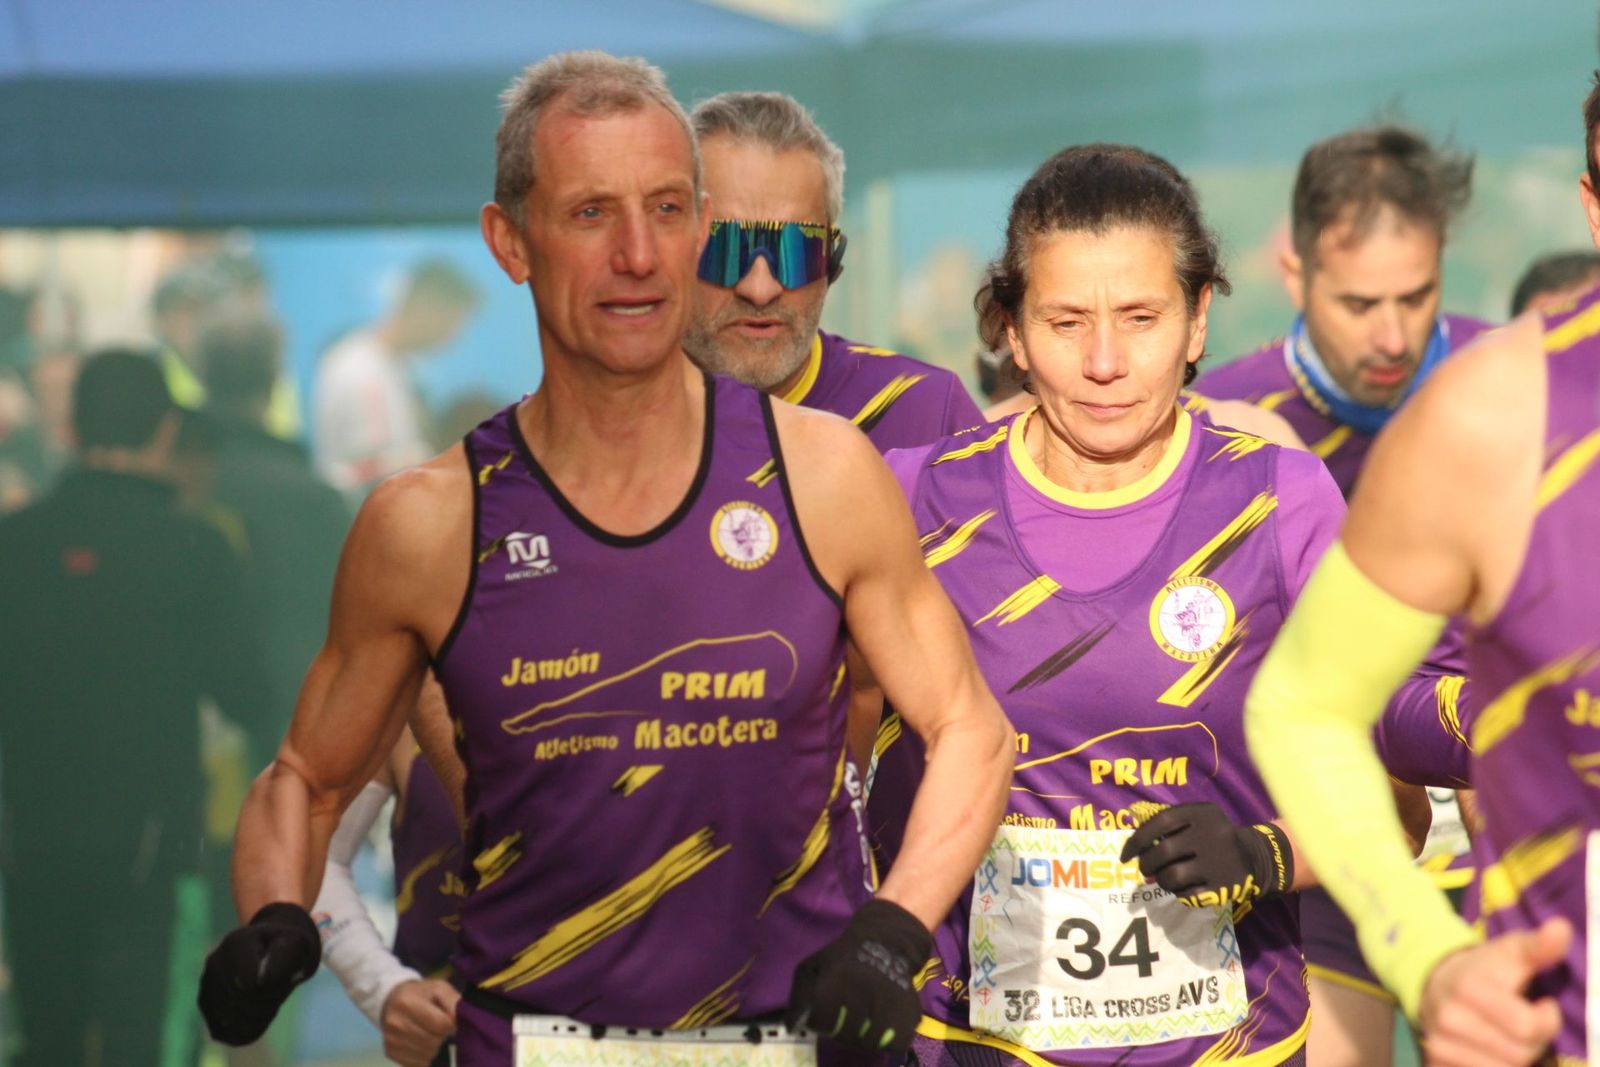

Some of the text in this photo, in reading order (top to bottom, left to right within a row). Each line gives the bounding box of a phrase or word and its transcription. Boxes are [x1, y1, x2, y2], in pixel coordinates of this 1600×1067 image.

[501, 648, 599, 686] Jamón
[661, 669, 766, 700] PRIM
[535, 715, 777, 760] Atletismo Macotera
[1090, 757, 1188, 786] PRIM
[1001, 812, 1057, 828] etismo
[1056, 917, 1160, 981] 34
[1004, 989, 1040, 1022] 32
[1104, 993, 1170, 1018] CROSS
[1176, 975, 1219, 1010] AVS
